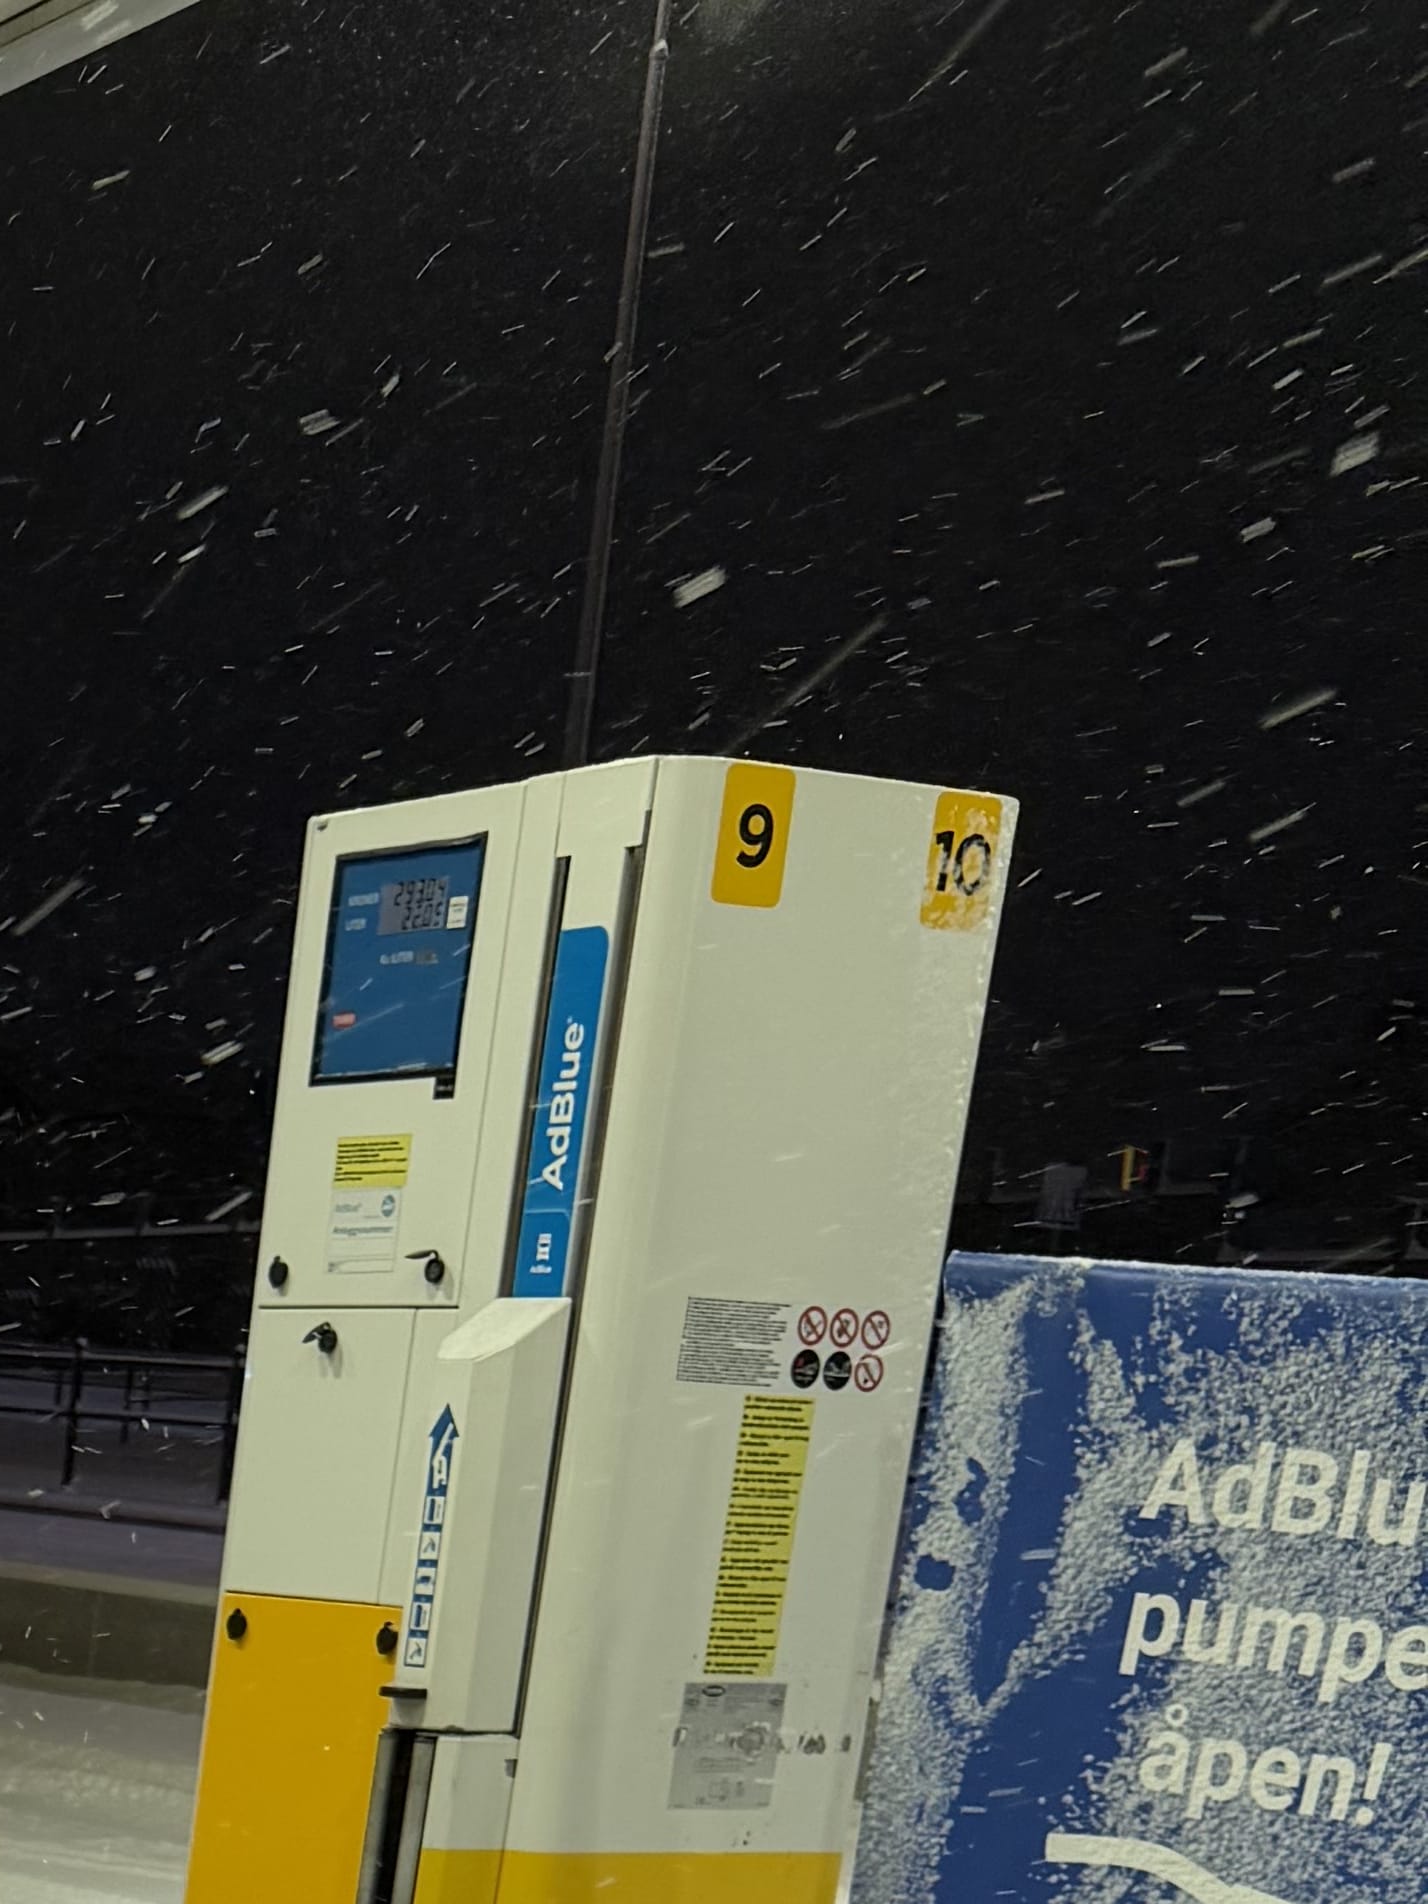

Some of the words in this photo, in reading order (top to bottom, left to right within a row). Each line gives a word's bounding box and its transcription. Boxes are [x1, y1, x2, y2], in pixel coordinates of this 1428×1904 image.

[736, 803, 774, 868] 9
[936, 830, 991, 896] 10
[542, 1022, 584, 1190] AdBlue
[1140, 1703, 1393, 1827] åpen!
